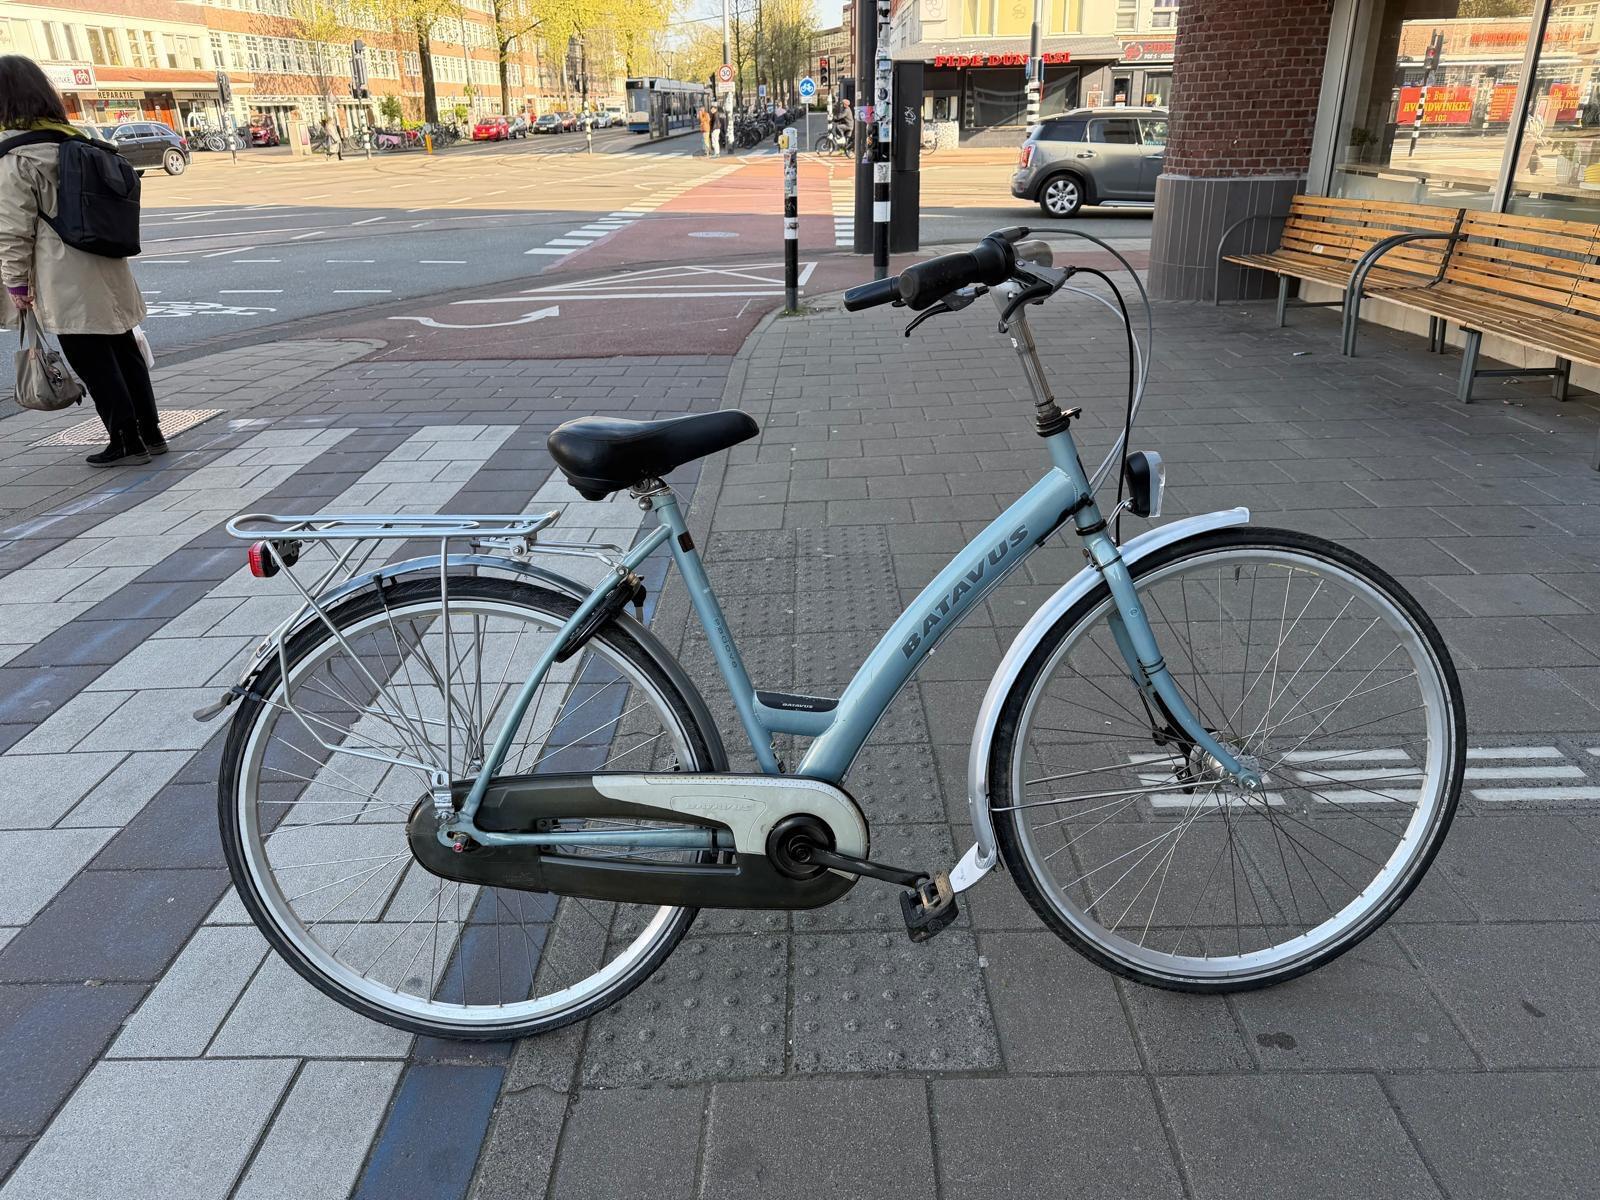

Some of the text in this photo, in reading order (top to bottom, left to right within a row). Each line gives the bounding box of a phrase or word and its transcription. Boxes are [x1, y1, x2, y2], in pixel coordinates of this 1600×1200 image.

[934, 51, 1071, 67] PIDE DÜNASI
[722, 69, 730, 77] 30
[98, 91, 135, 99] REPARATIE
[1403, 101, 1471, 112] AVNDWINKEL
[901, 524, 1029, 660] BATAVUS
